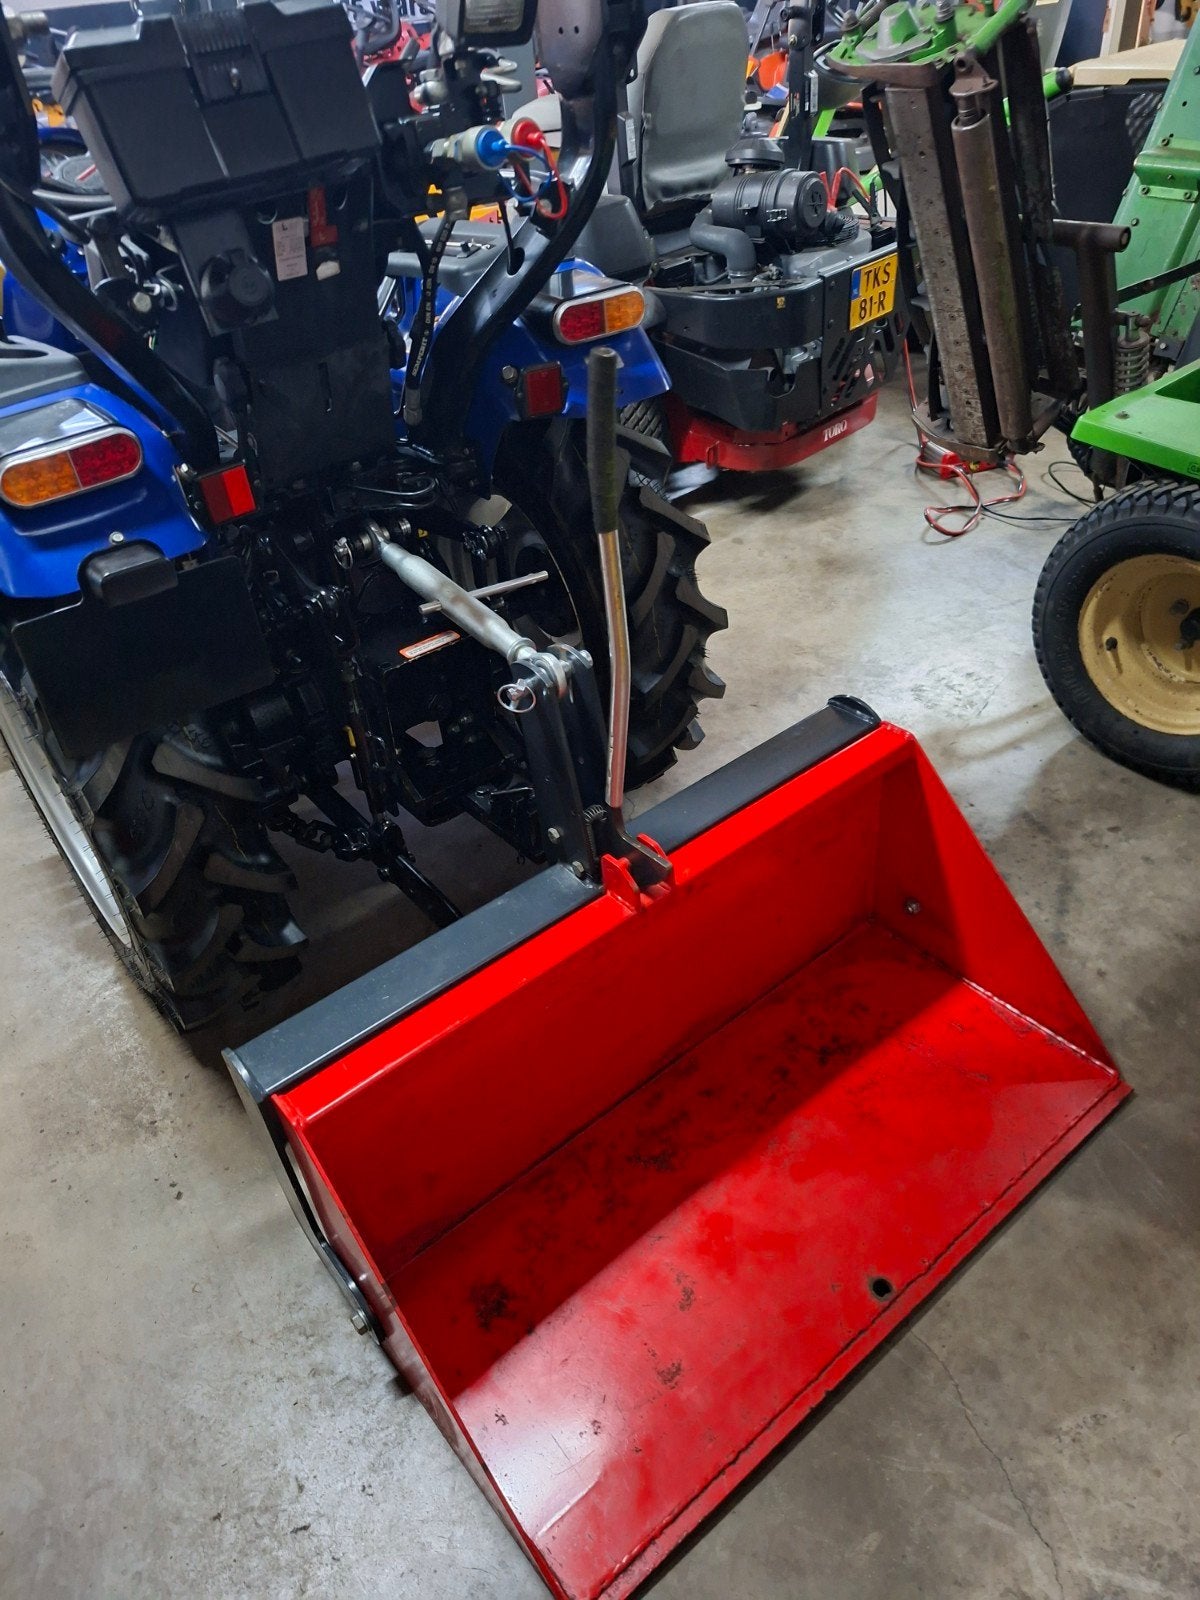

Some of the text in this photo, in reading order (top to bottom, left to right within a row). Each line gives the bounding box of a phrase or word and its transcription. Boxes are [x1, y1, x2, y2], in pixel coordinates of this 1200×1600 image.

[864, 261, 891, 293] TKS
[859, 290, 886, 320] 81-R
[823, 419, 848, 442] TORO
